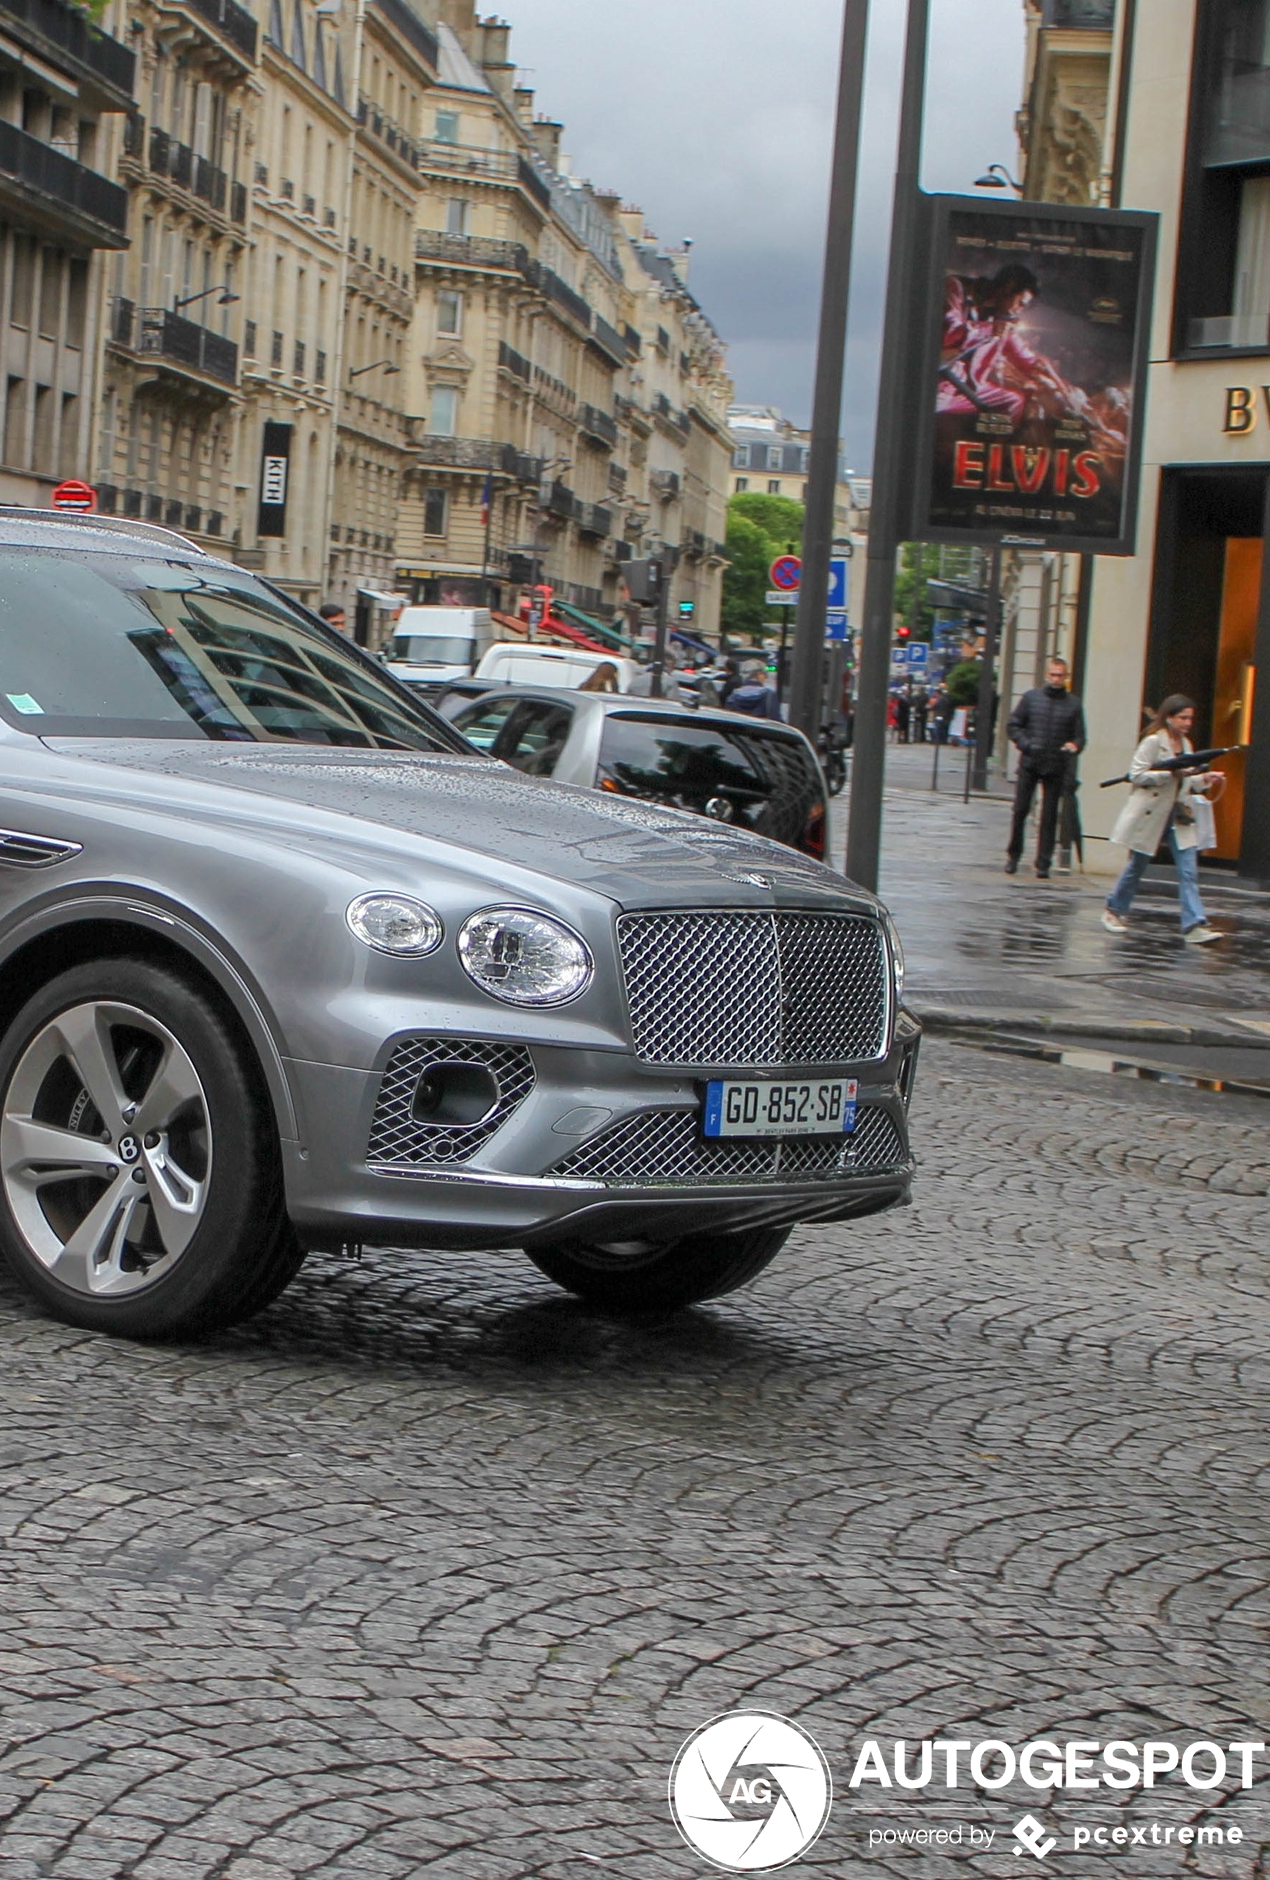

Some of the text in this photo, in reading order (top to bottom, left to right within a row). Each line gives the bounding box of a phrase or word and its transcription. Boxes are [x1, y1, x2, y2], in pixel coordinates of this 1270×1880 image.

[952, 440, 1101, 498] ELVIS
[266, 459, 283, 501] KITH
[911, 647, 924, 661] P
[710, 1113, 717, 1126] F
[844, 1107, 856, 1125] 75
